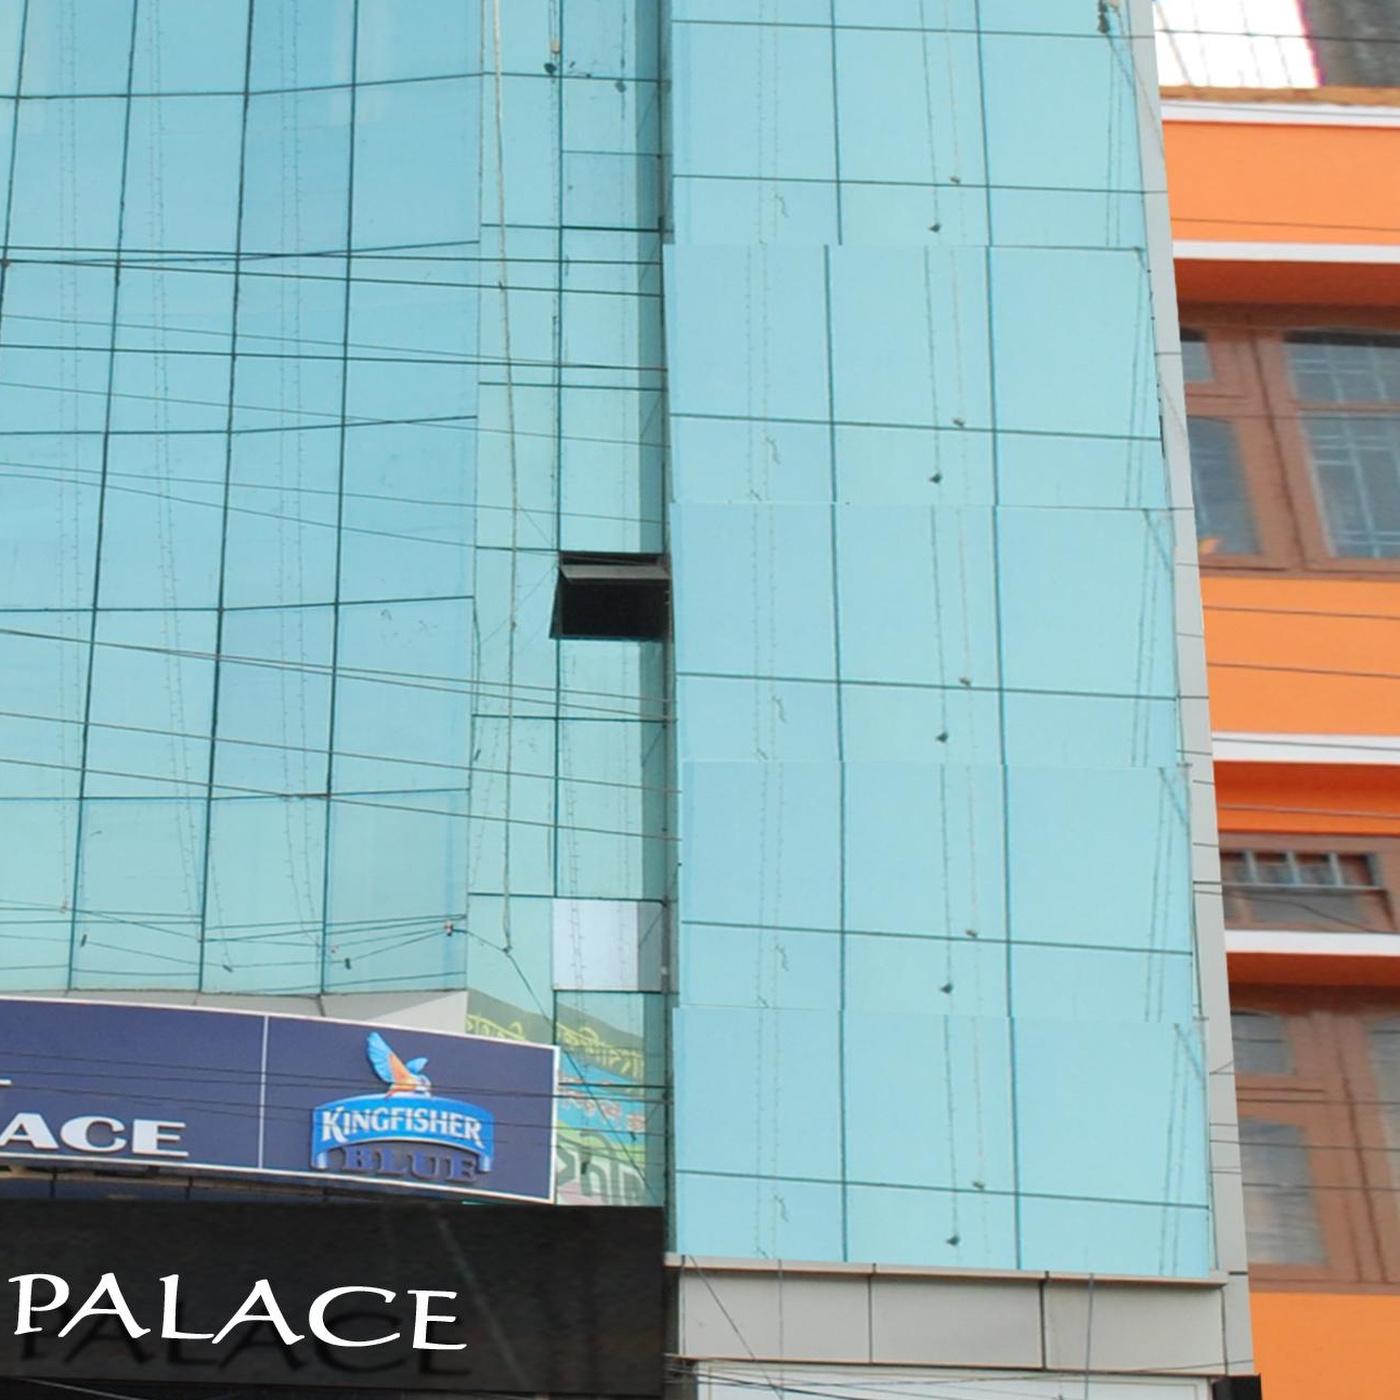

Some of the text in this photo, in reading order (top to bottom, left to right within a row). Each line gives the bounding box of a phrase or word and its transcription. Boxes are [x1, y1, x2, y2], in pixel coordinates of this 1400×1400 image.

[320, 1106, 485, 1150] KINGFISHER
[344, 1144, 478, 1183] BLUE
[7, 1271, 469, 1351] PALACE
